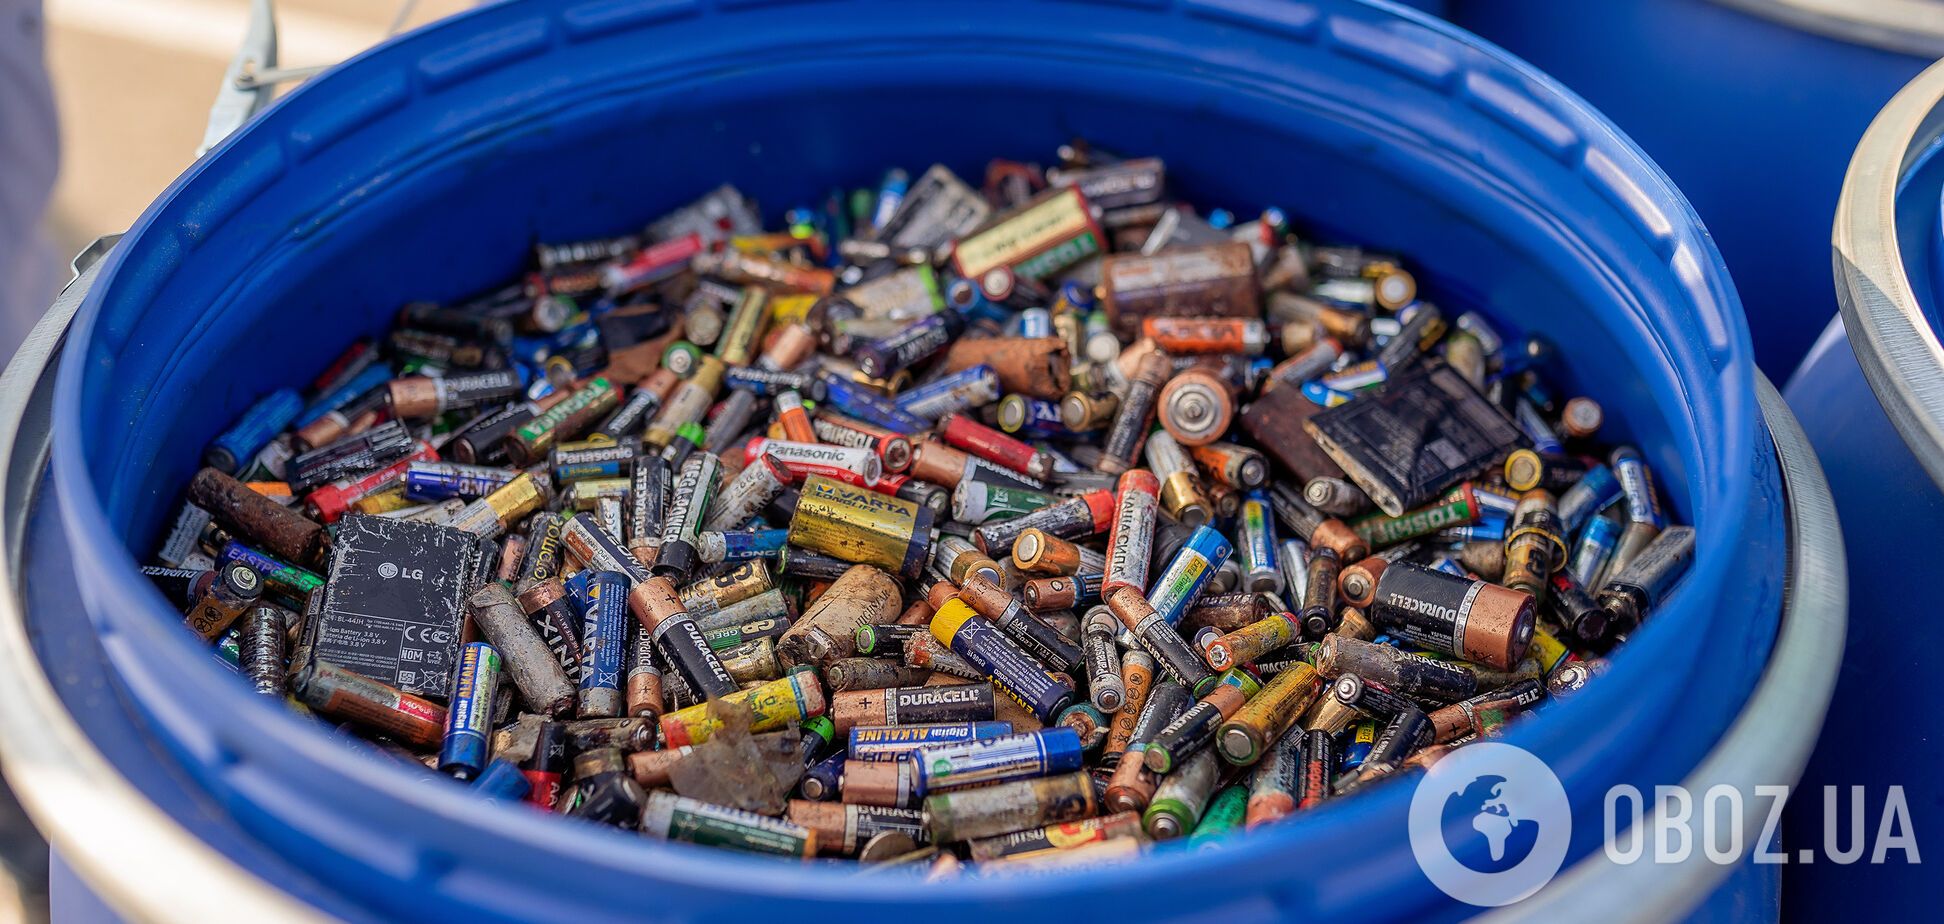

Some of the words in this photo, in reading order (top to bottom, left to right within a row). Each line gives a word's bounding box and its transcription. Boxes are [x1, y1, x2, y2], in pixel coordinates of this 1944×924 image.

[557, 446, 634, 465] Panasonic
[766, 442, 846, 463] Panasonic
[635, 467, 648, 536] DURACELL
[816, 491, 878, 513] LONGLIFE
[834, 489, 911, 517] VARTA
[597, 549, 609, 562] Duty
[727, 549, 777, 559] LONG
[401, 567, 424, 581] LG
[715, 561, 753, 586] GP
[1188, 559, 1203, 576] Extra
[1175, 574, 1192, 593] Power
[856, 588, 891, 625] HIGHSTAR
[1389, 592, 1457, 622] DURACELL
[337, 616, 364, 625] BL-44JH
[741, 618, 776, 634] GP
[1012, 617, 1028, 632] AAA
[340, 627, 362, 636] Battery
[405, 625, 432, 643] CE
[580, 603, 599, 684] VARTA
[682, 622, 731, 683] DURACELL
[401, 648, 423, 660] NOM
[1095, 635, 1109, 675] Panasonic
[1143, 637, 1187, 686] DURACELL
[458, 646, 479, 699] ALKALINE
[993, 668, 1016, 688] 12-2020
[900, 689, 978, 707] DURACELL
[986, 674, 1034, 714] ENERGY
[401, 700, 424, 713] +40%
[454, 699, 468, 729] Digital
[857, 729, 931, 742] ALKALINE
[550, 781, 559, 806] AA
